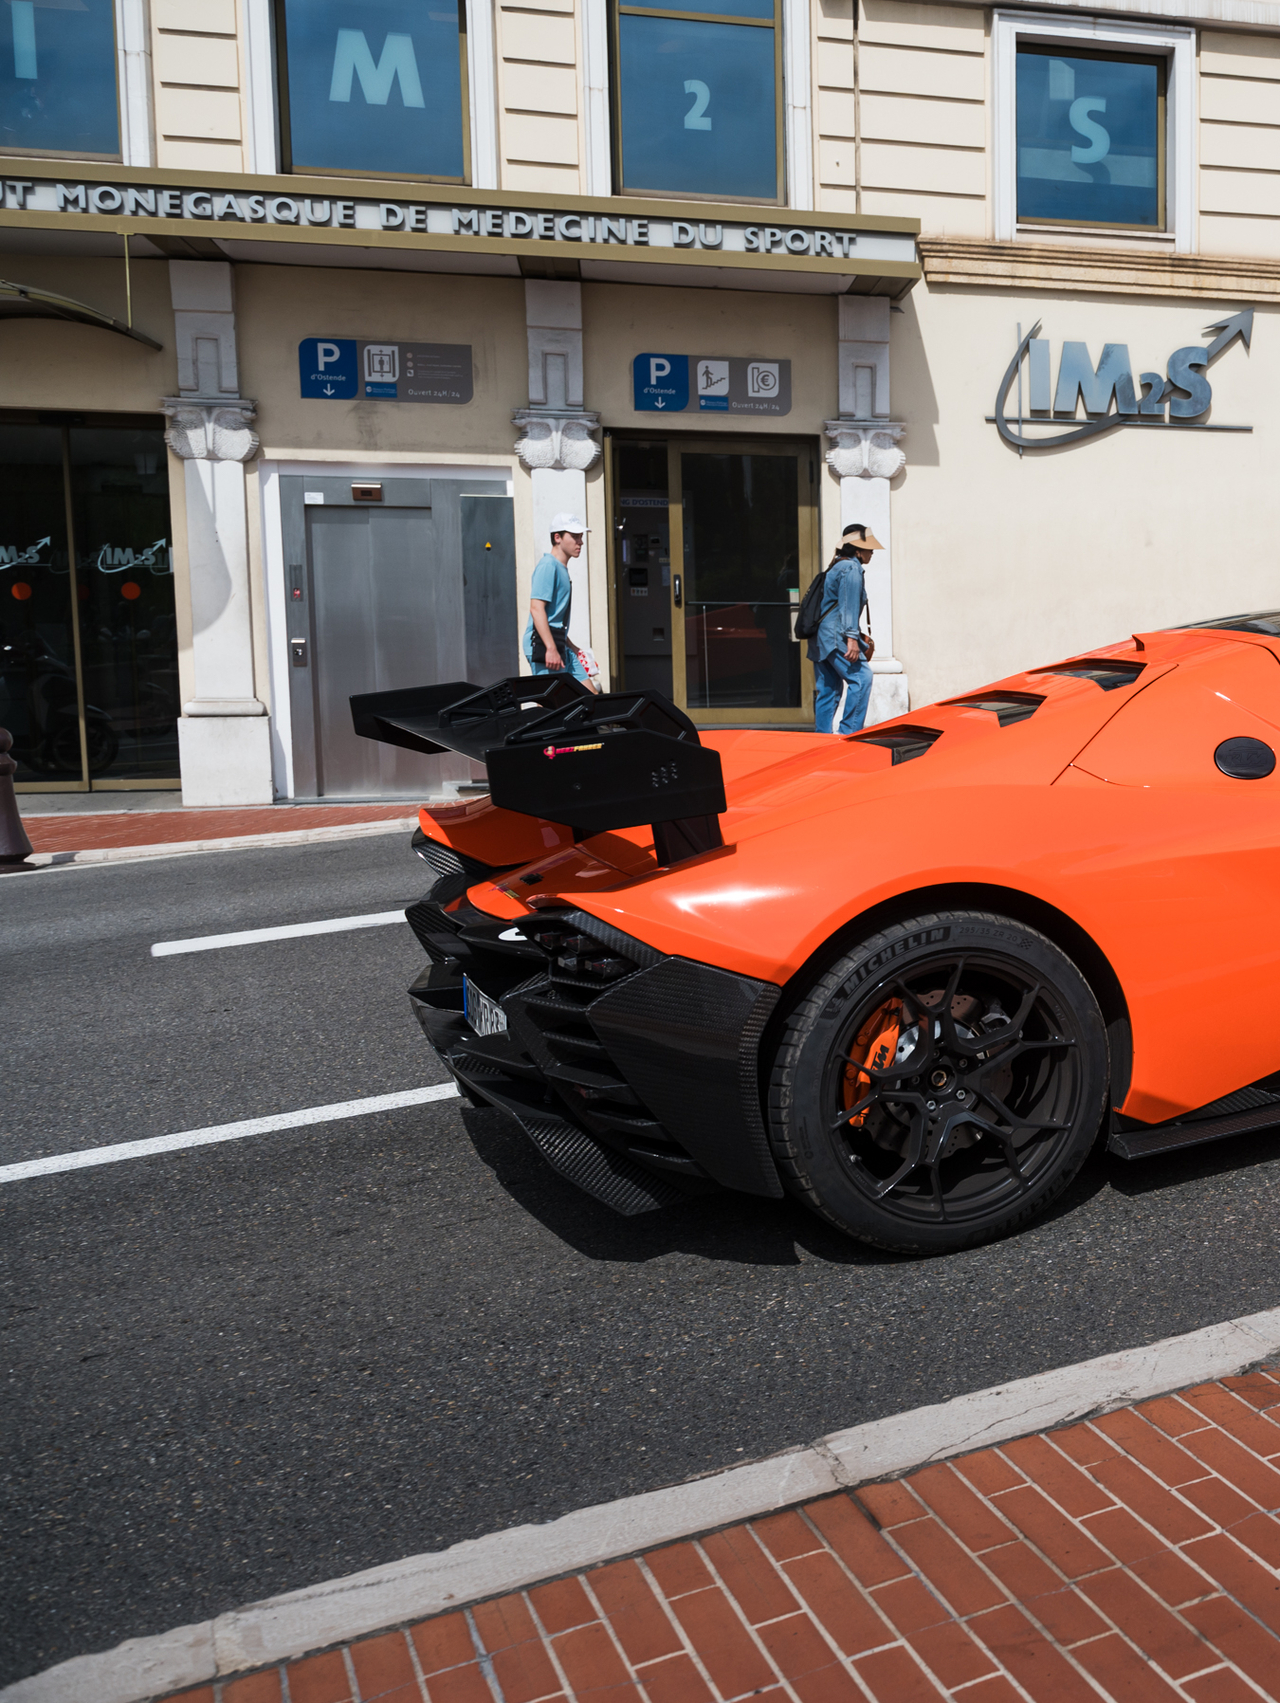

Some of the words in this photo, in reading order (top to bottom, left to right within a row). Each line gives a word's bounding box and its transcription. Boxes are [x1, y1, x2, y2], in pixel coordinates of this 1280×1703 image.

[329, 28, 425, 108] M
[683, 79, 712, 131] 2
[1068, 95, 1111, 164] S
[55, 183, 356, 226] MONEGASQUE
[380, 203, 428, 230] DE
[451, 208, 649, 245] MEDECINE
[672, 222, 723, 249] DU
[744, 226, 857, 258] SPORT
[317, 343, 340, 371] P
[650, 357, 671, 385] P
[643, 387, 676, 395] d'Ostende
[1029, 338, 1213, 418] IM2S
[732, 401, 754, 409] Ouvert
[106, 547, 156, 565] IM2S
[959, 926, 990, 935] 295/35
[993, 929, 1005, 938] ZR
[1007, 933, 1018, 942] 20
[843, 928, 945, 995] MICHELIN
